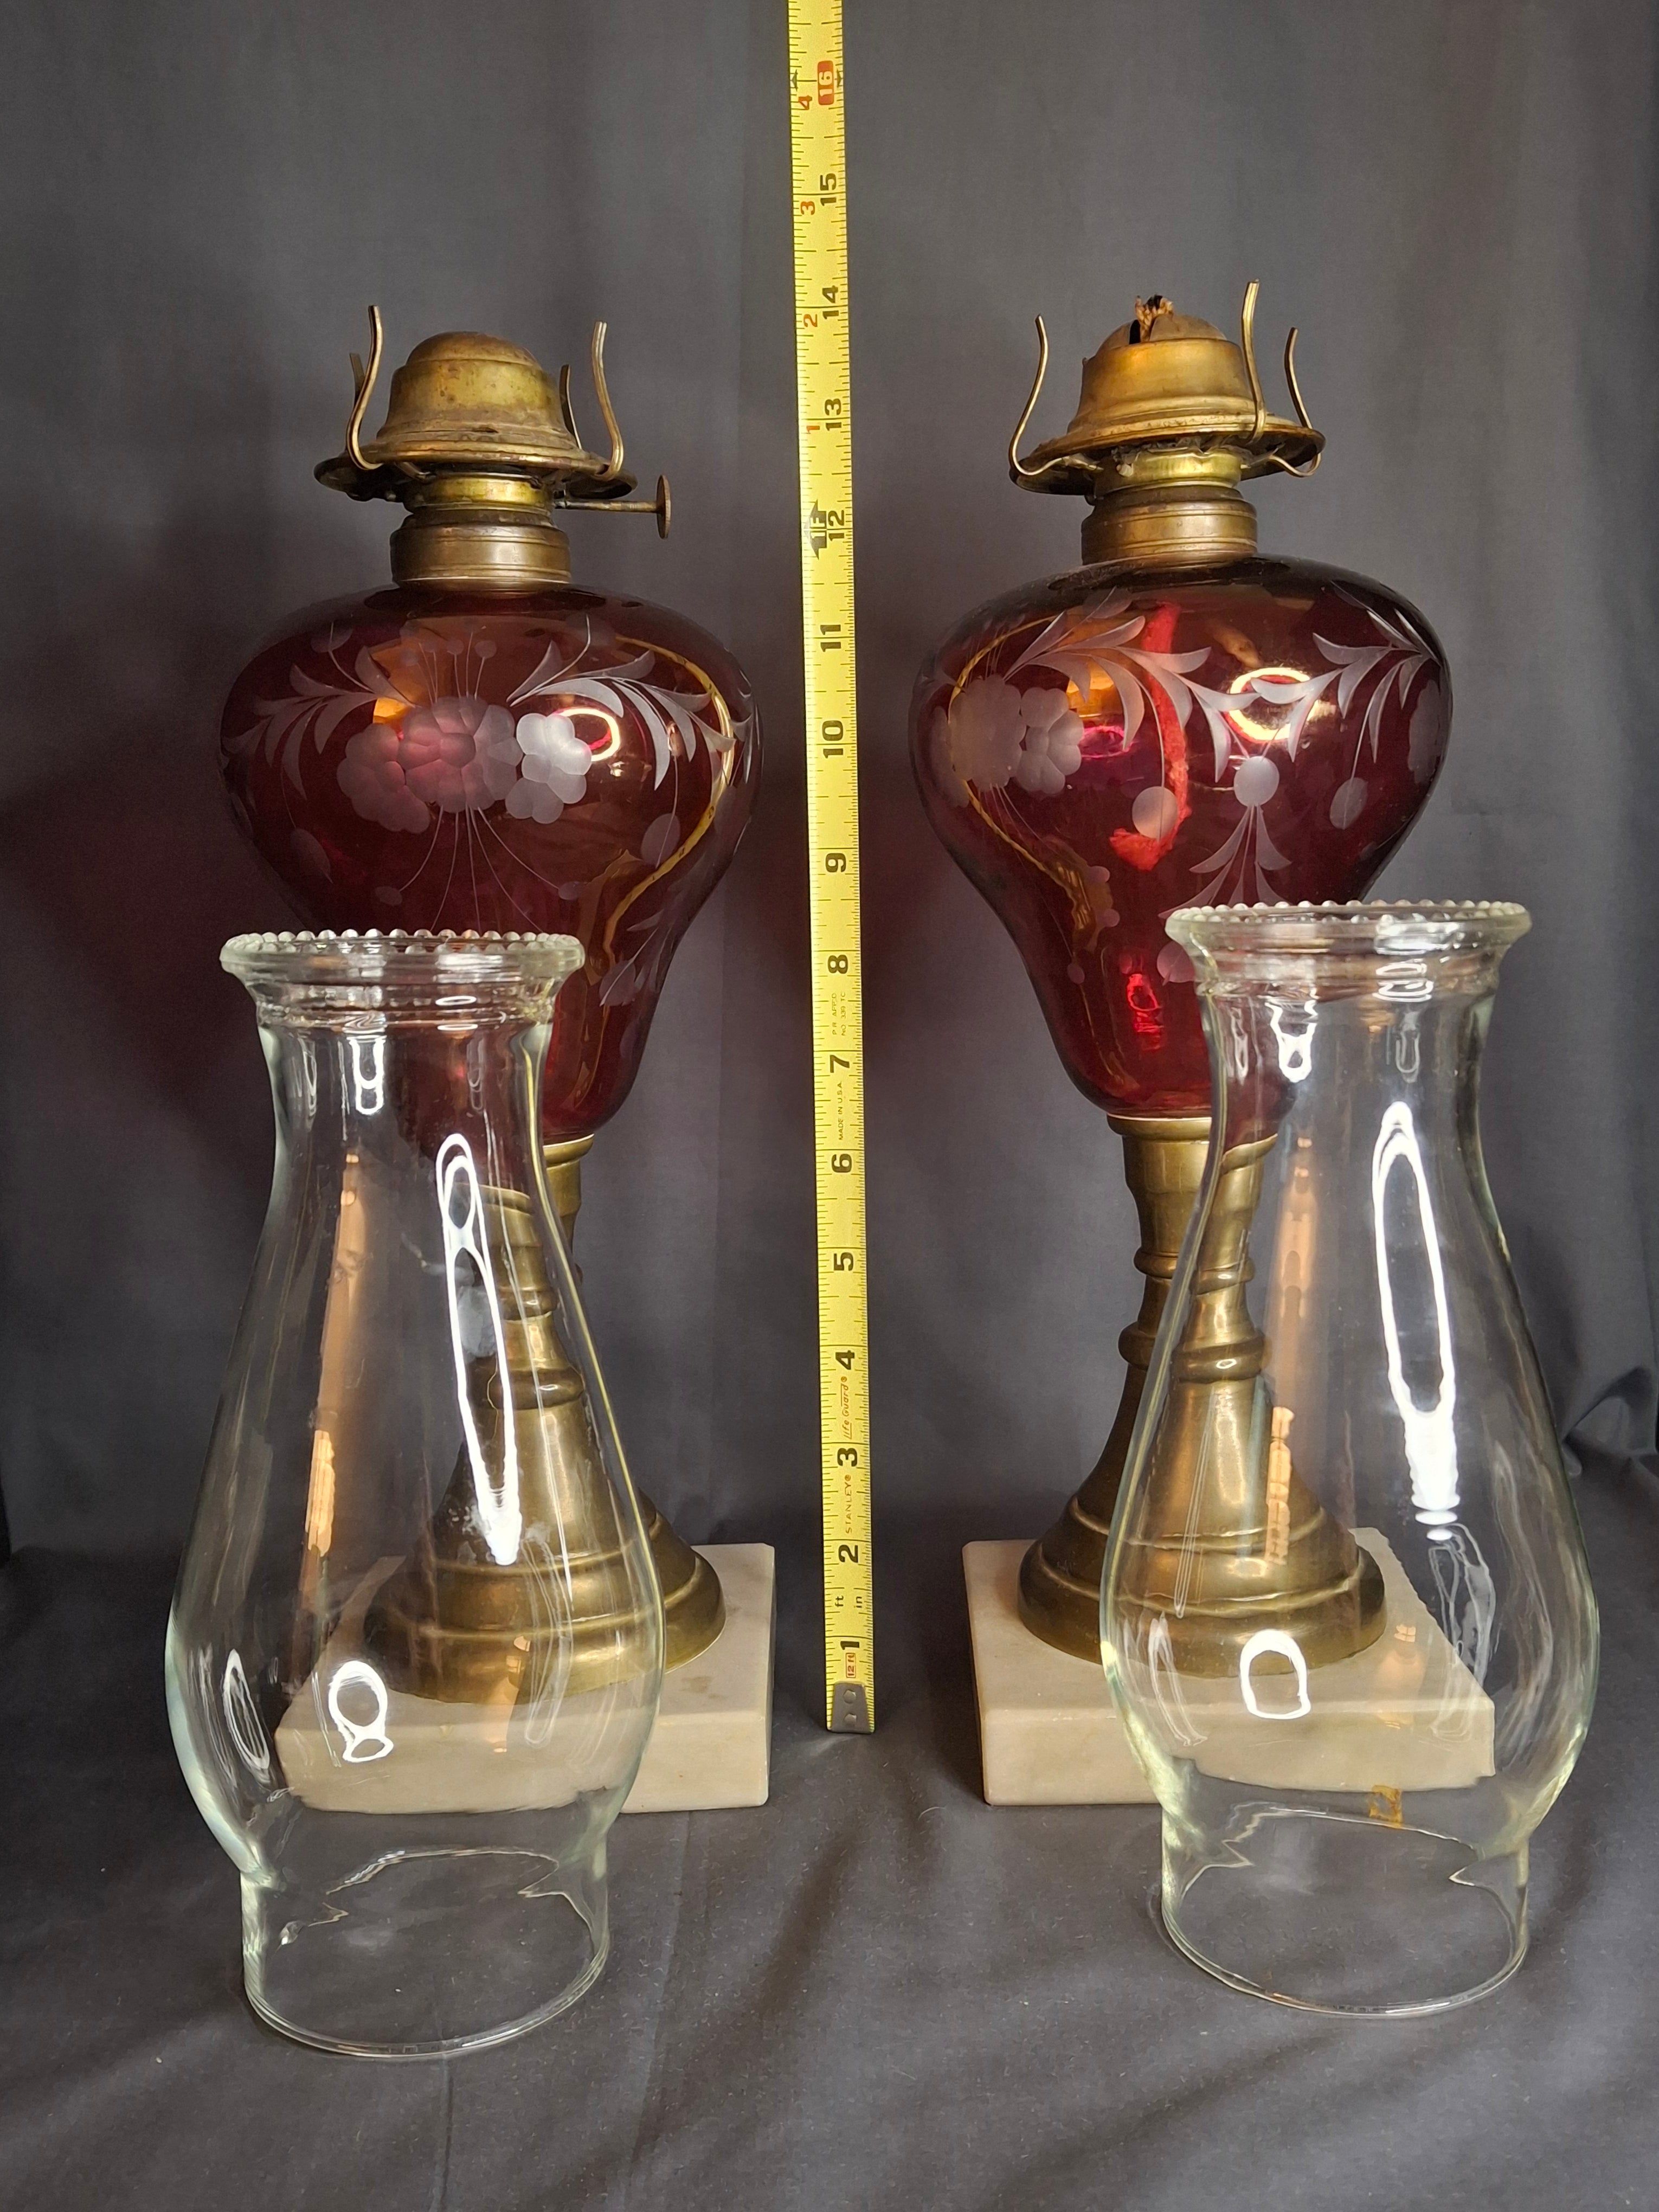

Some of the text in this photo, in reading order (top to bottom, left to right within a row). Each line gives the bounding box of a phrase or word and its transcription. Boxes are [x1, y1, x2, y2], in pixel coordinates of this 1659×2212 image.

[819, 70, 833, 98] 16
[798, 95, 813, 111] 4
[819, 172, 837, 207] 15
[800, 201, 815, 215] 3
[822, 285, 839, 320] 14
[803, 313, 818, 328] 2
[824, 398, 842, 432] 13
[806, 425, 820, 434] 1
[828, 510, 845, 542] 12
[820, 624, 841, 653] 11
[821, 719, 844, 759] 10
[825, 852, 847, 873] 9
[827, 954, 848, 974] 8
[829, 1054, 850, 1073] 7
[838, 1106, 843, 1115] IN
[831, 1153, 852, 1173] 6
[833, 1251, 854, 1271] 5
[835, 1349, 855, 1371] 4
[840, 1383, 850, 1417] Guard
[837, 1448, 858, 1467] 3
[838, 1544, 858, 1564] 2
[835, 1595, 844, 1607] ft
[853, 1596, 863, 1609] in
[840, 1641, 859, 1650] 1
[847, 1665, 855, 1676] 12
